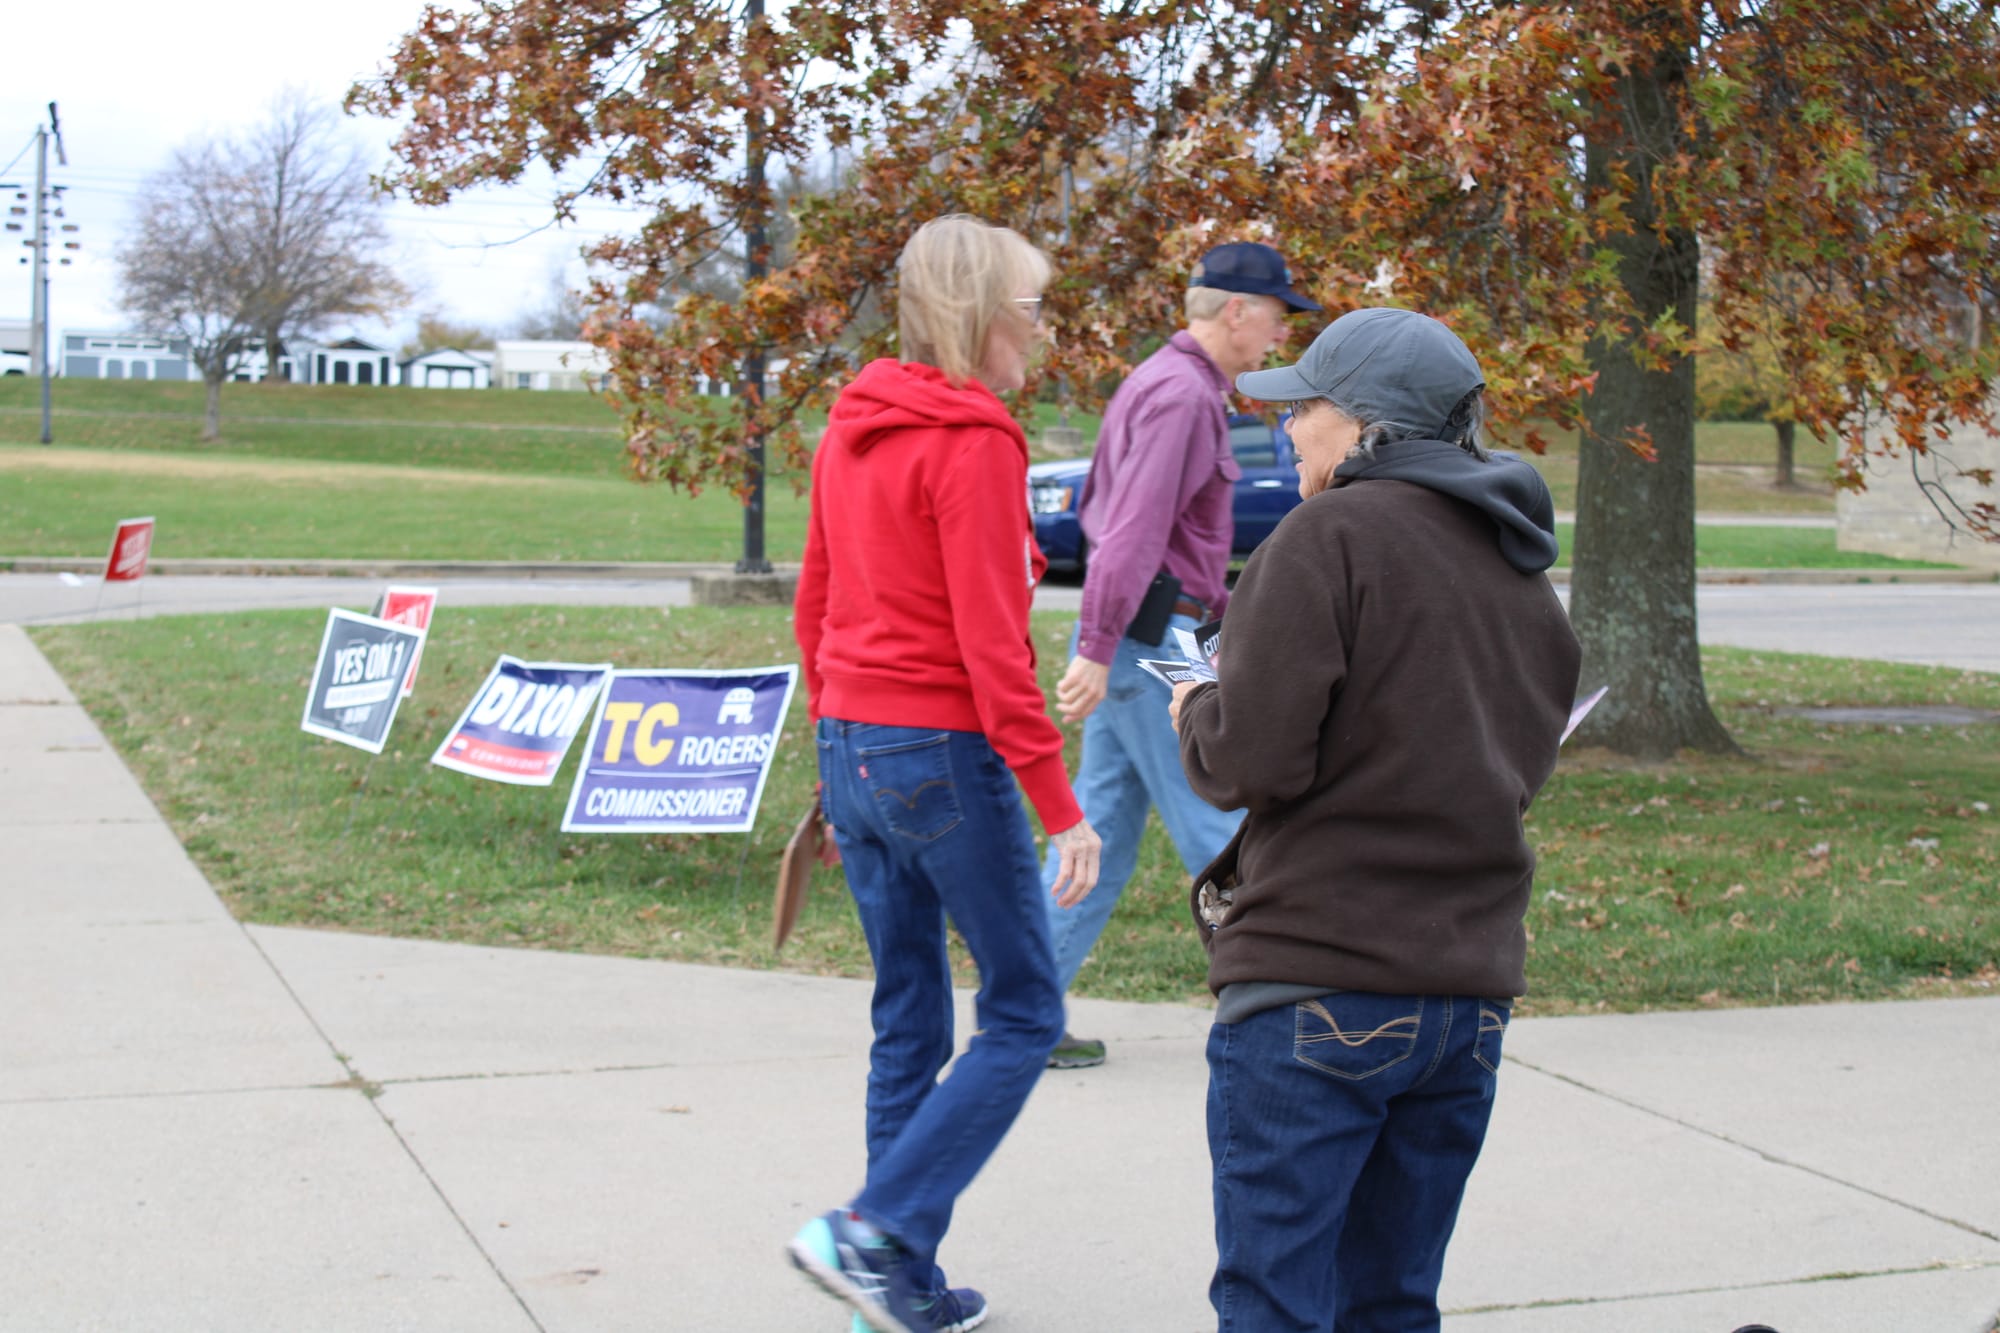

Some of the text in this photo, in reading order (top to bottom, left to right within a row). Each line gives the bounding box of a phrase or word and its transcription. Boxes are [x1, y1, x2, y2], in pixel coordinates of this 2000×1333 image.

[332, 639, 406, 685] YES ON 1
[469, 675, 603, 739] DIXON
[603, 701, 772, 767] TC ROGERS
[585, 786, 748, 818] COMMISSIONER
